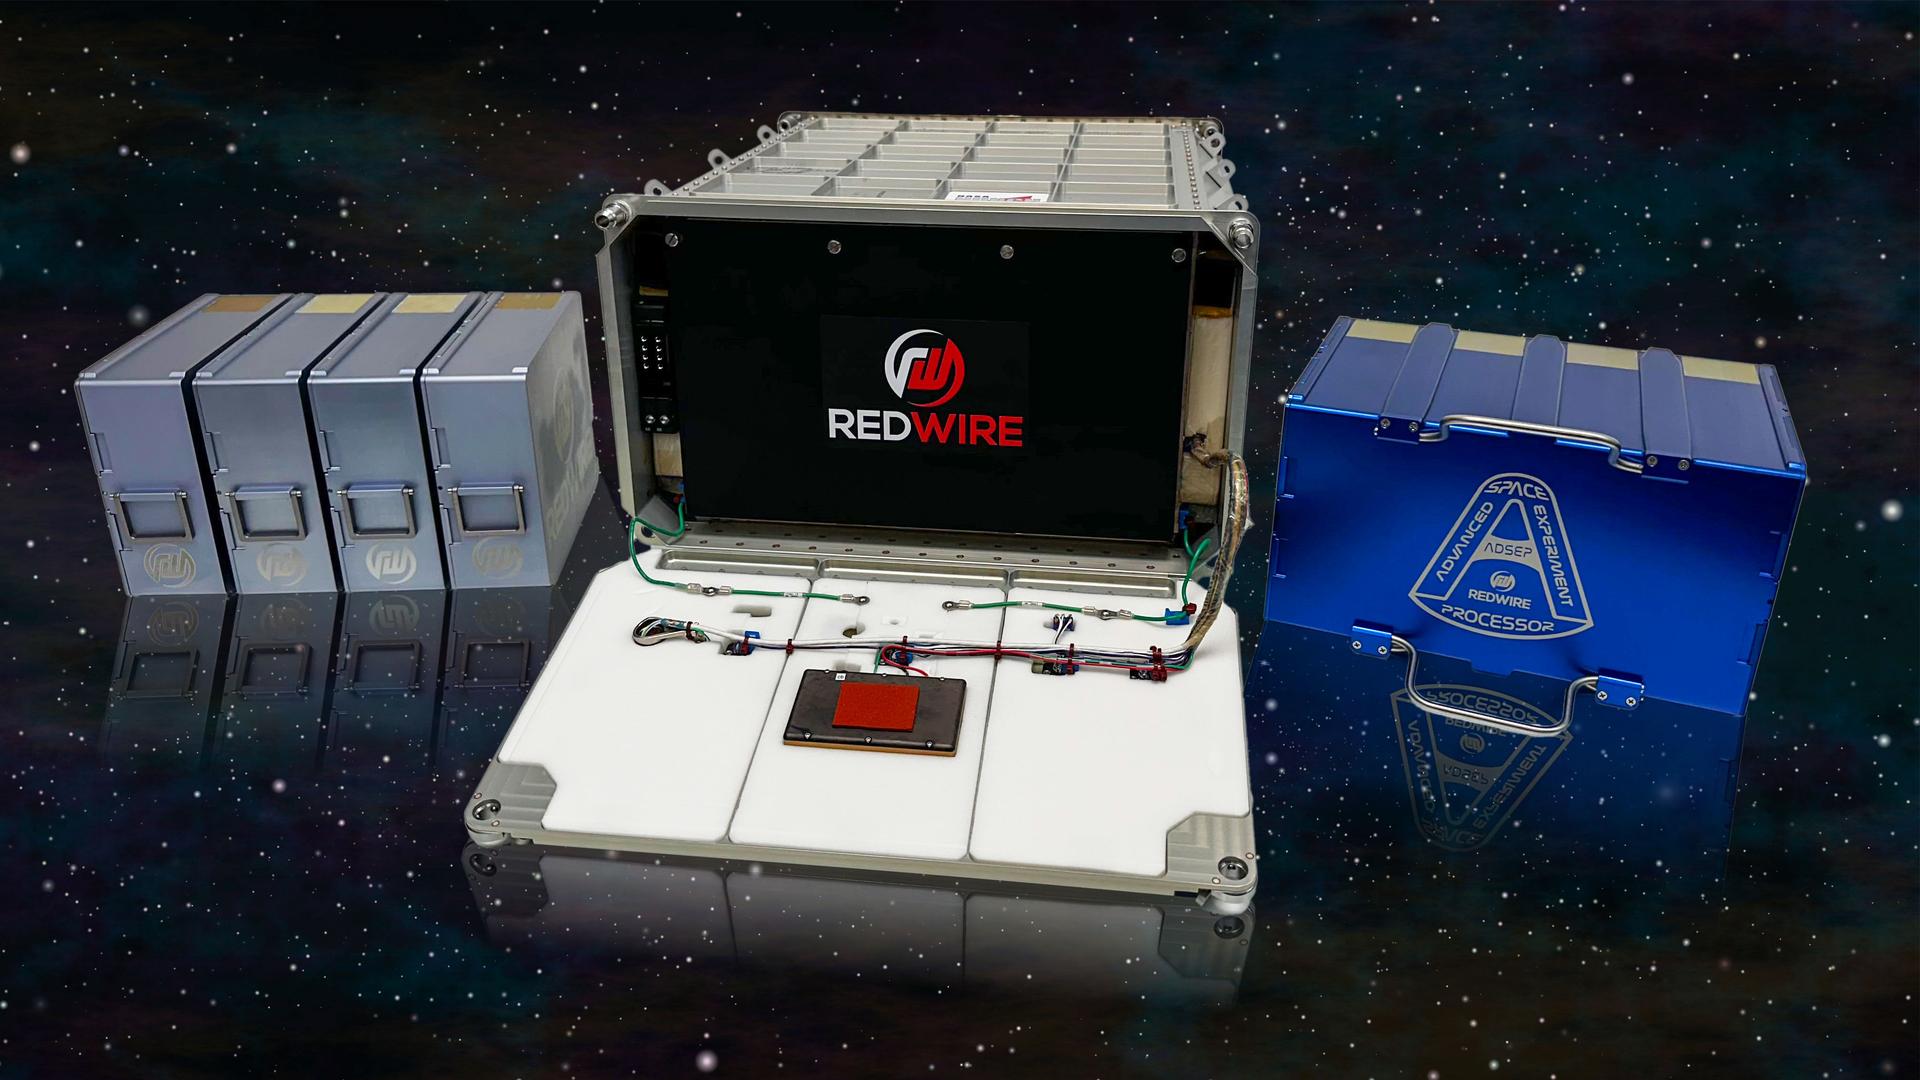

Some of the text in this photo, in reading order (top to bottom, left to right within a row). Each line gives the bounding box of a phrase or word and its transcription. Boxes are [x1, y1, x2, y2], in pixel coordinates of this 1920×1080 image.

[828, 407, 1024, 448] REDWIRE
[1484, 480, 1550, 501] SPACE
[1435, 501, 1494, 582] ADVANCED
[1484, 542, 1533, 558] ADSEP
[1533, 504, 1574, 607] EXPERIMENT
[1468, 588, 1532, 610] REDWIRE
[1441, 604, 1555, 632] PROCESSOR
